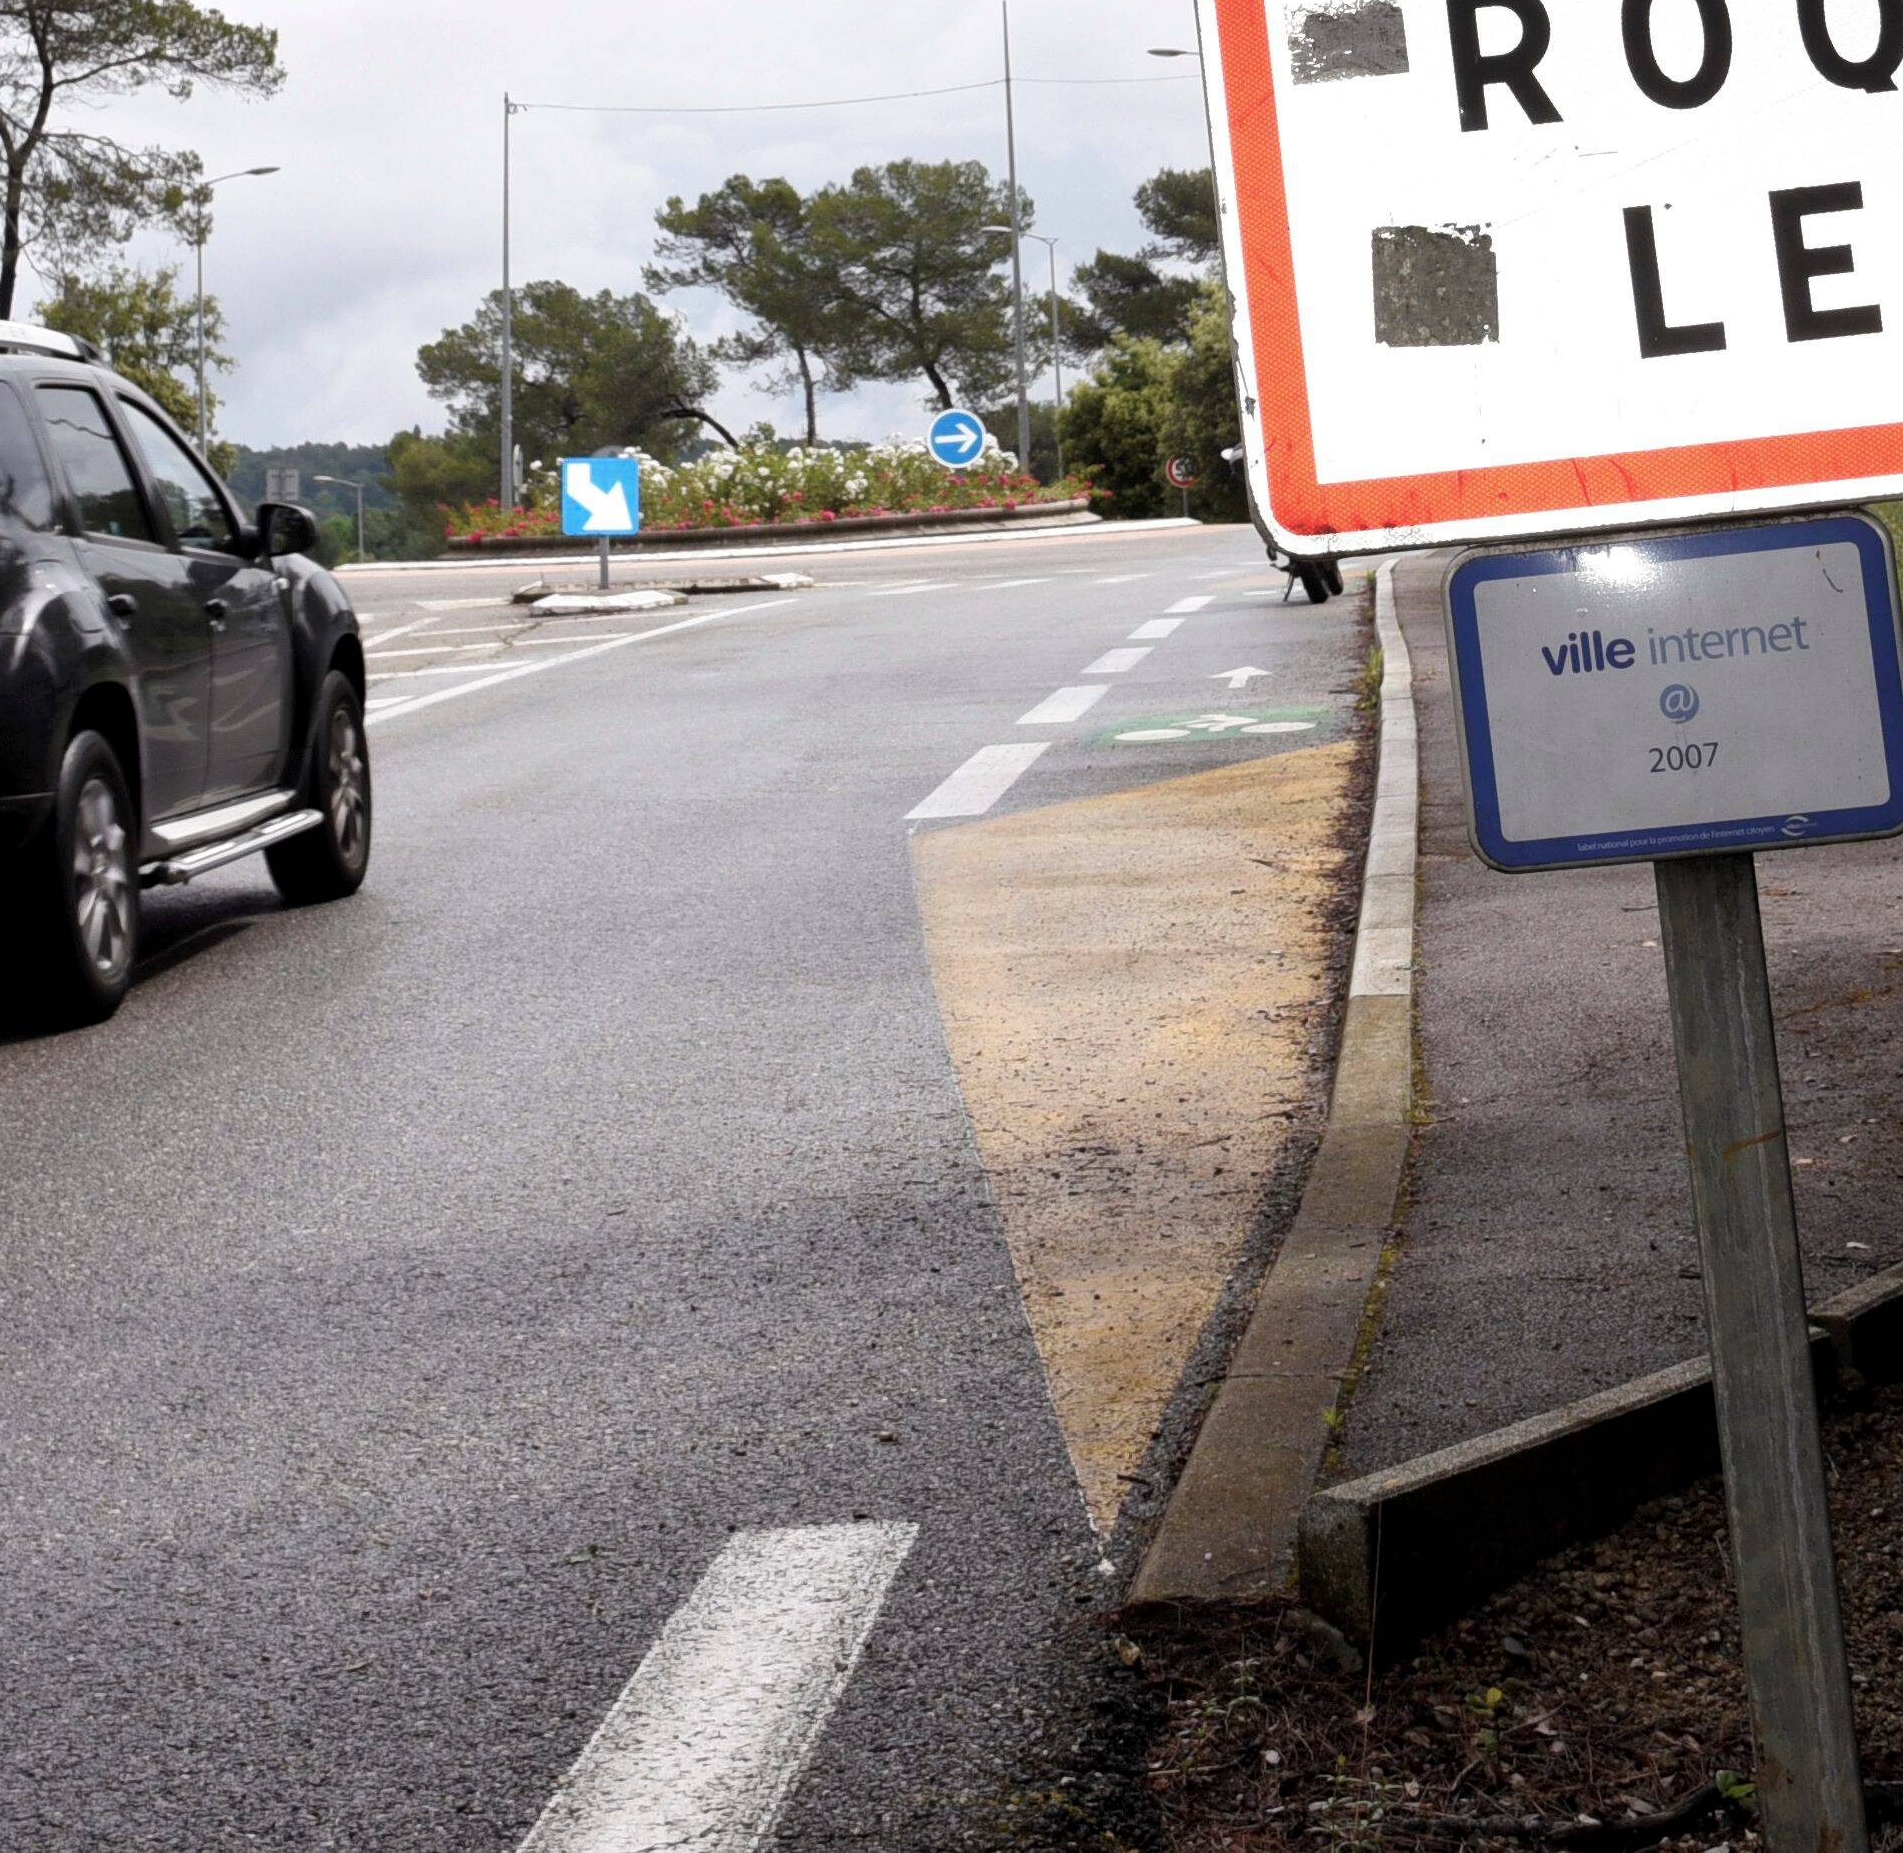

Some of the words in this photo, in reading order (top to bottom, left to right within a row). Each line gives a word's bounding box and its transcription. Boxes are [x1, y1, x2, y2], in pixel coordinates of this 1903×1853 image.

[1542, 631, 1636, 675] ville
[1648, 617, 1810, 665] internet
[1649, 742, 1719, 772] 2007
[1597, 839, 1628, 850] national
[1630, 839, 1648, 848] pour
[1658, 834, 1698, 844] promotion
